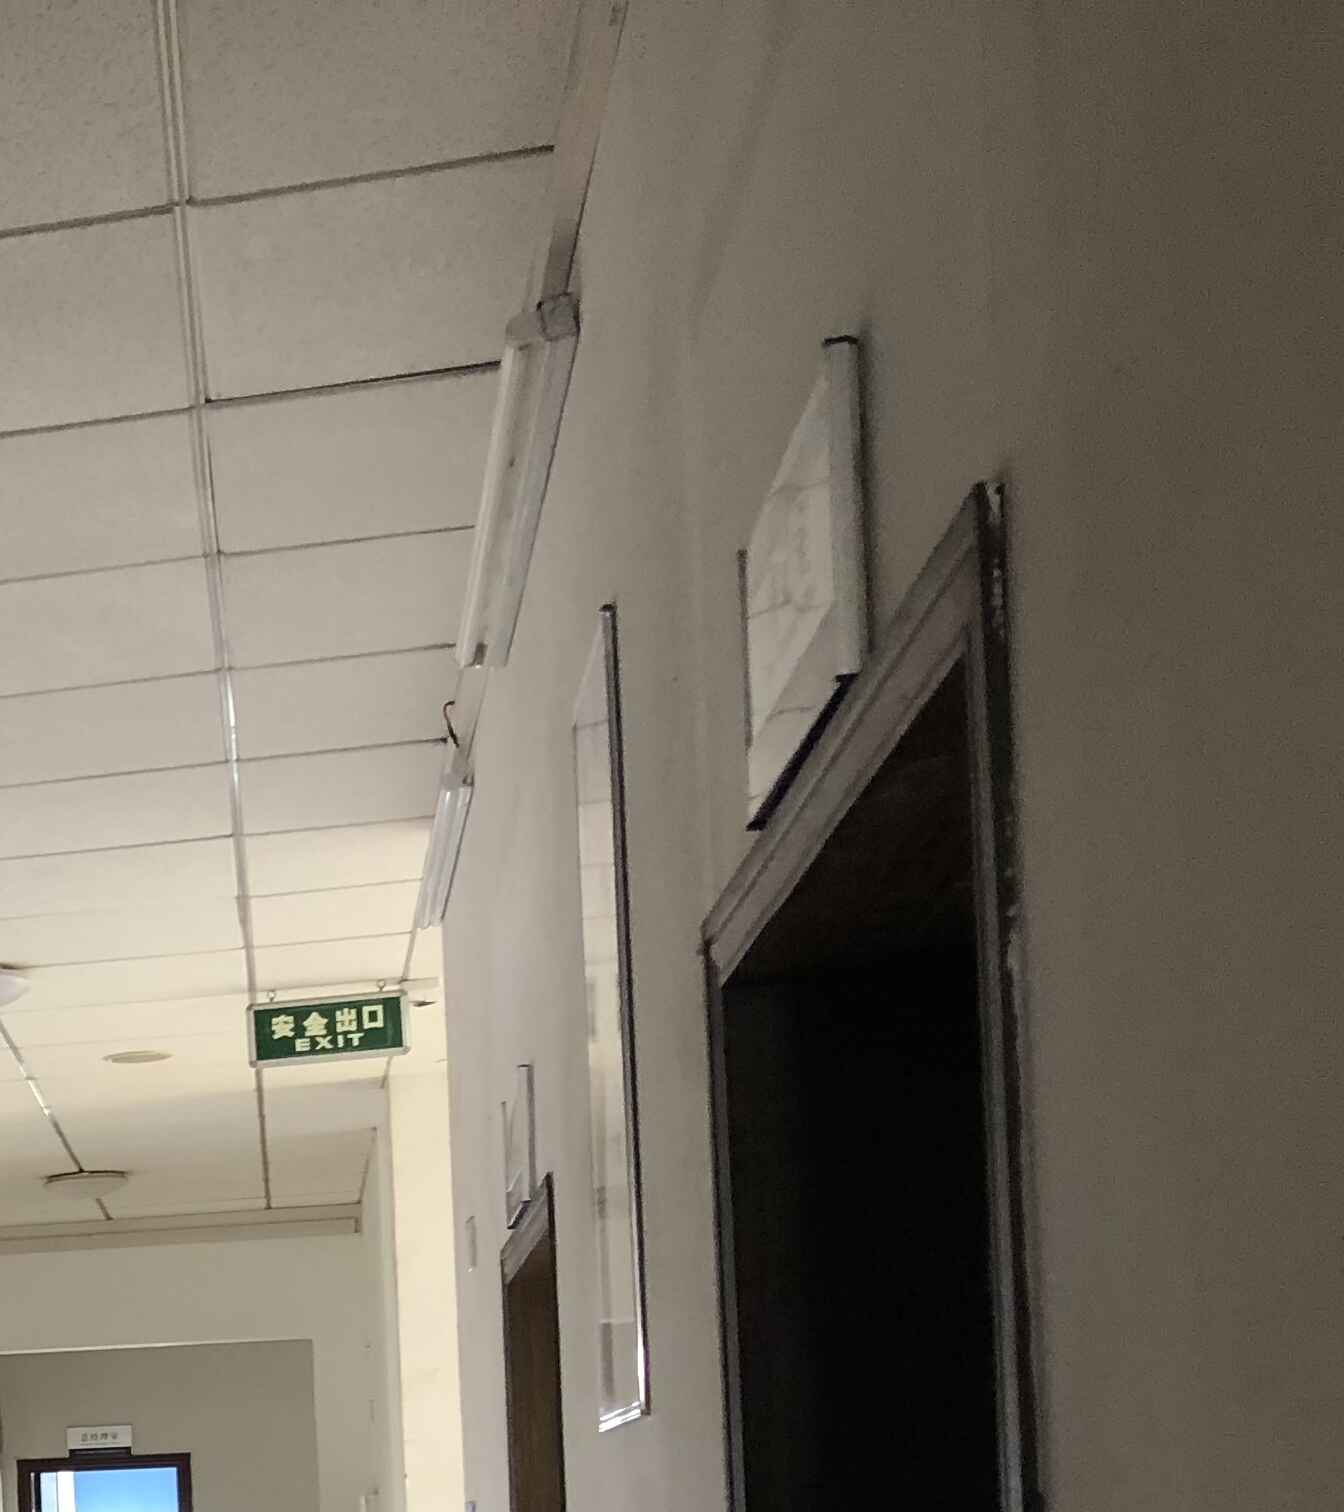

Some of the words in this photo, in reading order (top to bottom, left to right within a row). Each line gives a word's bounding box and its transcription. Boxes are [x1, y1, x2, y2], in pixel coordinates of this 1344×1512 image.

[272, 1005, 384, 1040] 安全出口
[295, 1033, 365, 1051] EXIT
